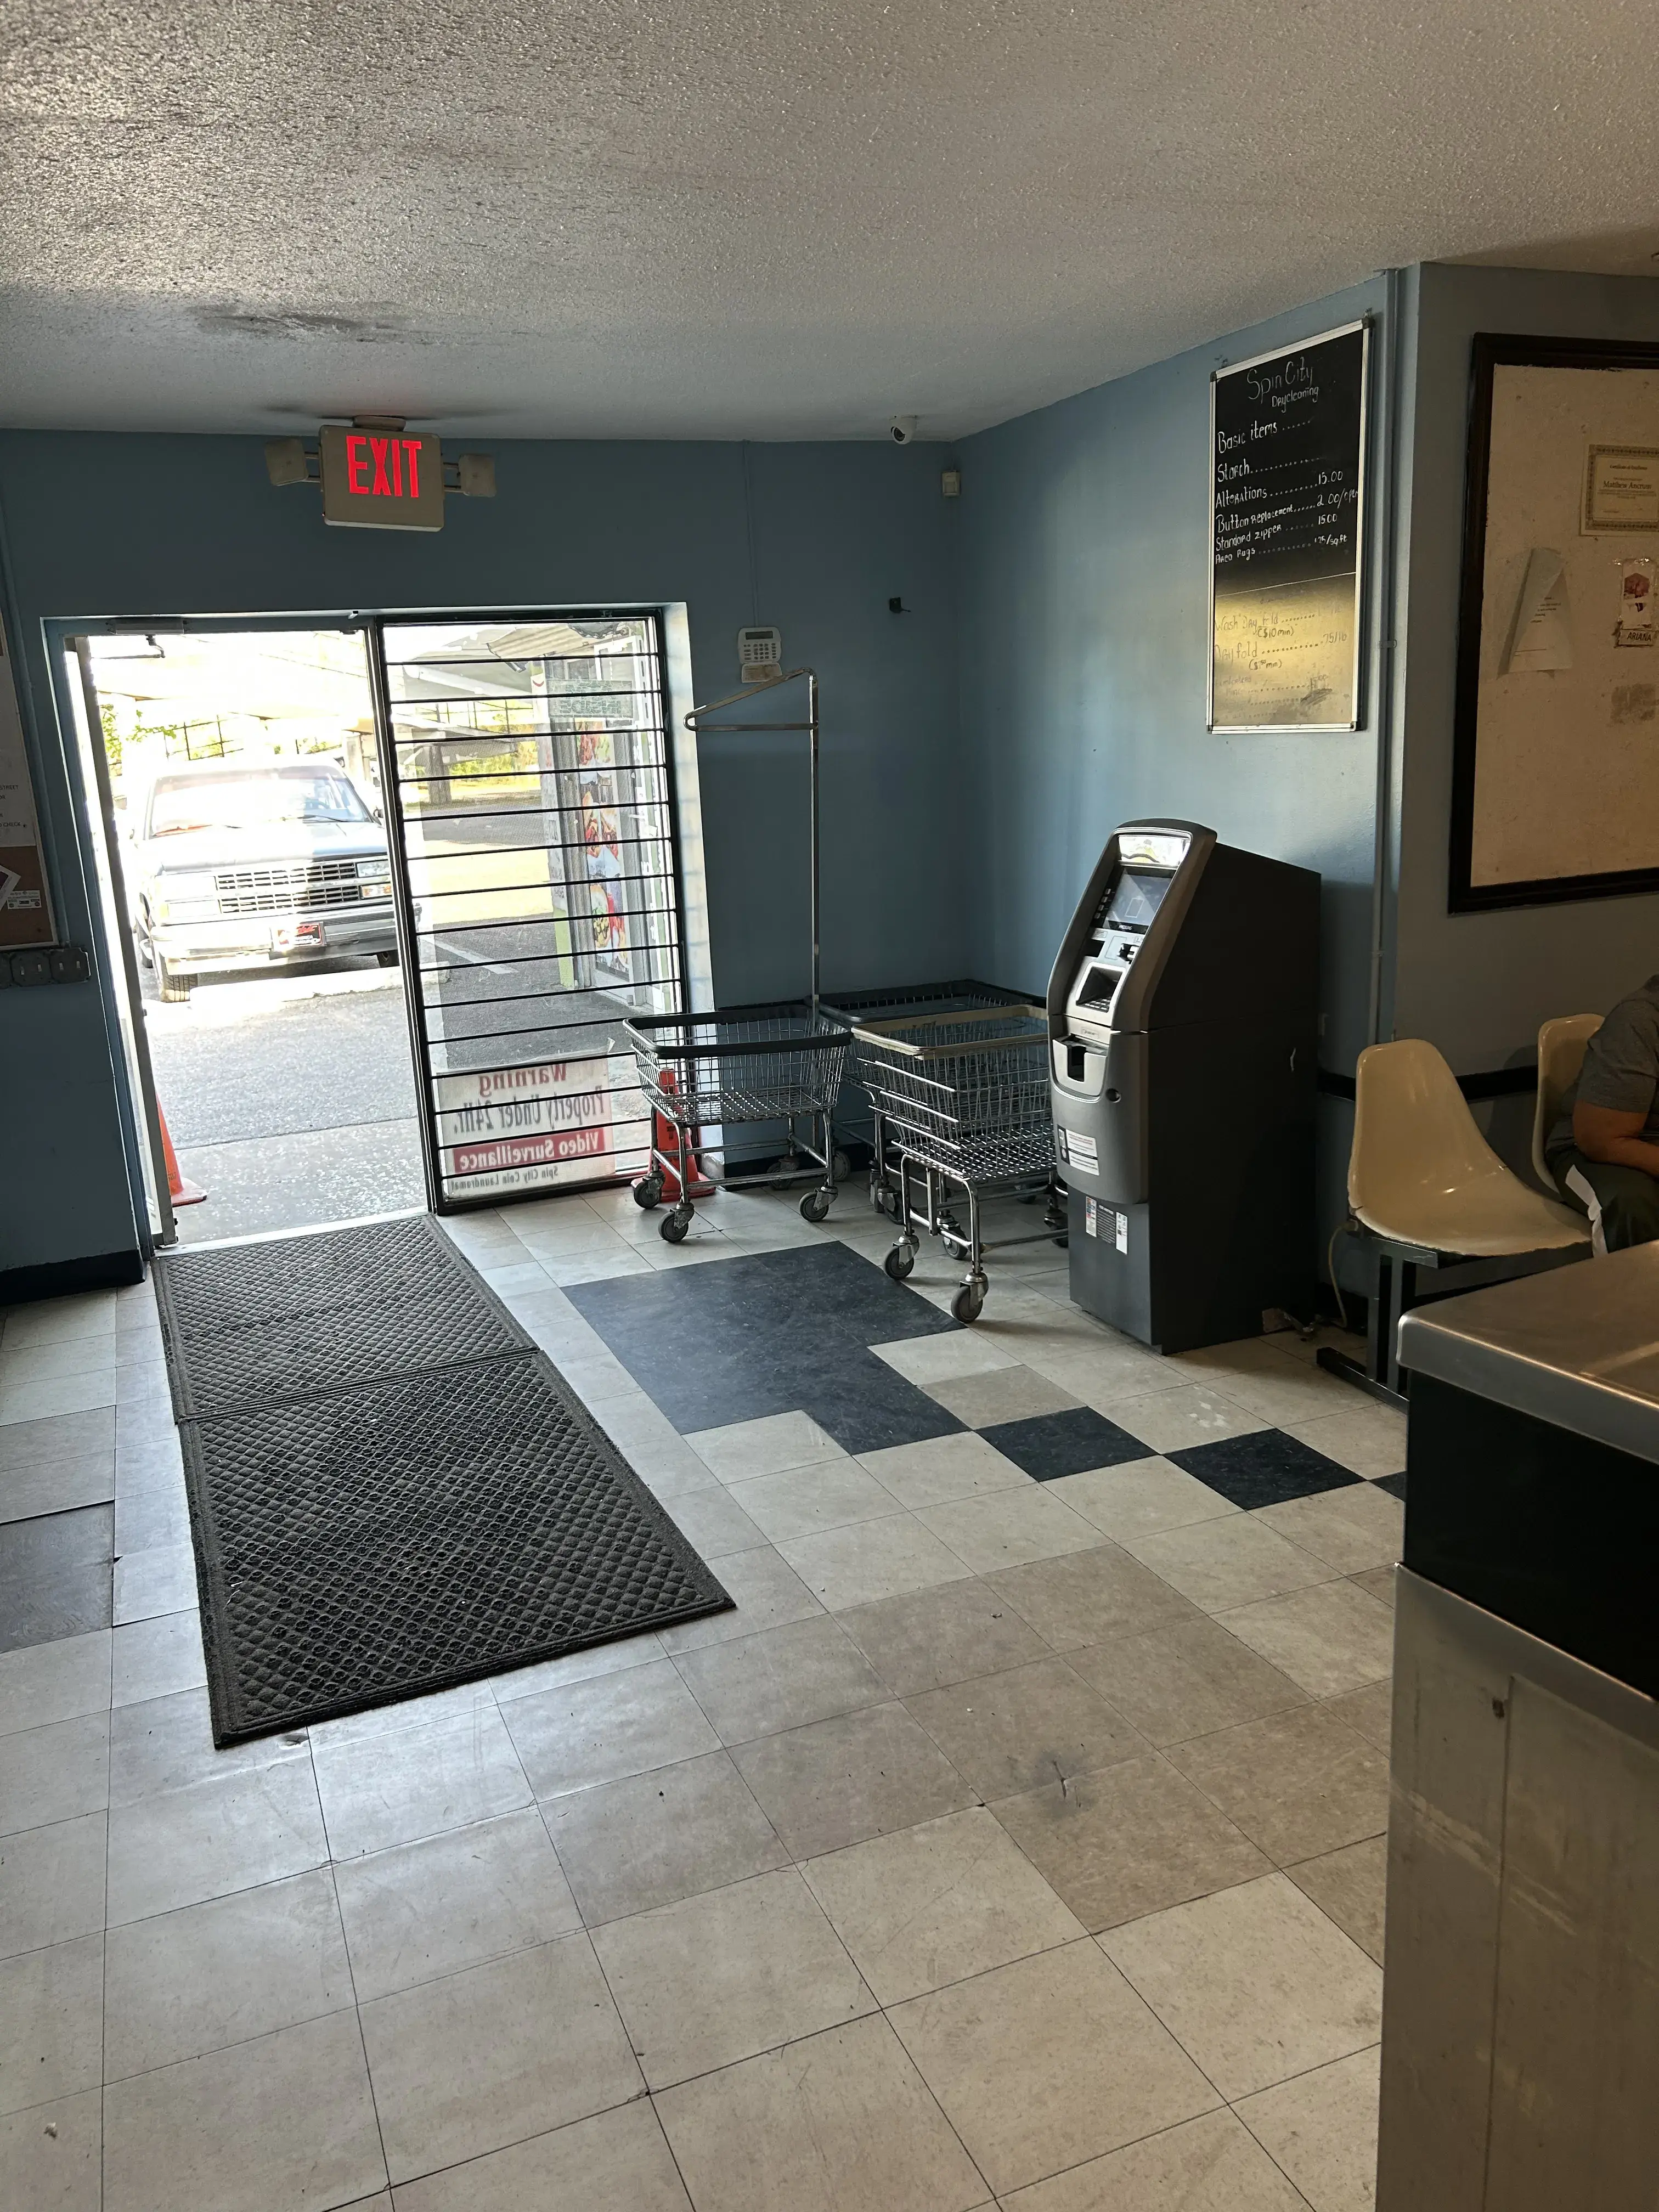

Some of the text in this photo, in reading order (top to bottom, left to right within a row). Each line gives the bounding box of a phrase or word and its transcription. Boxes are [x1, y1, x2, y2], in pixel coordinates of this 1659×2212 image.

[1247, 356, 1314, 404] Spin City
[1217, 420, 1278, 454] Basic items
[346, 435, 422, 498] EXIT
[1215, 514, 1249, 533] Button
[1627, 631, 1652, 641] ARIANA
[1237, 641, 1257, 659] fold
